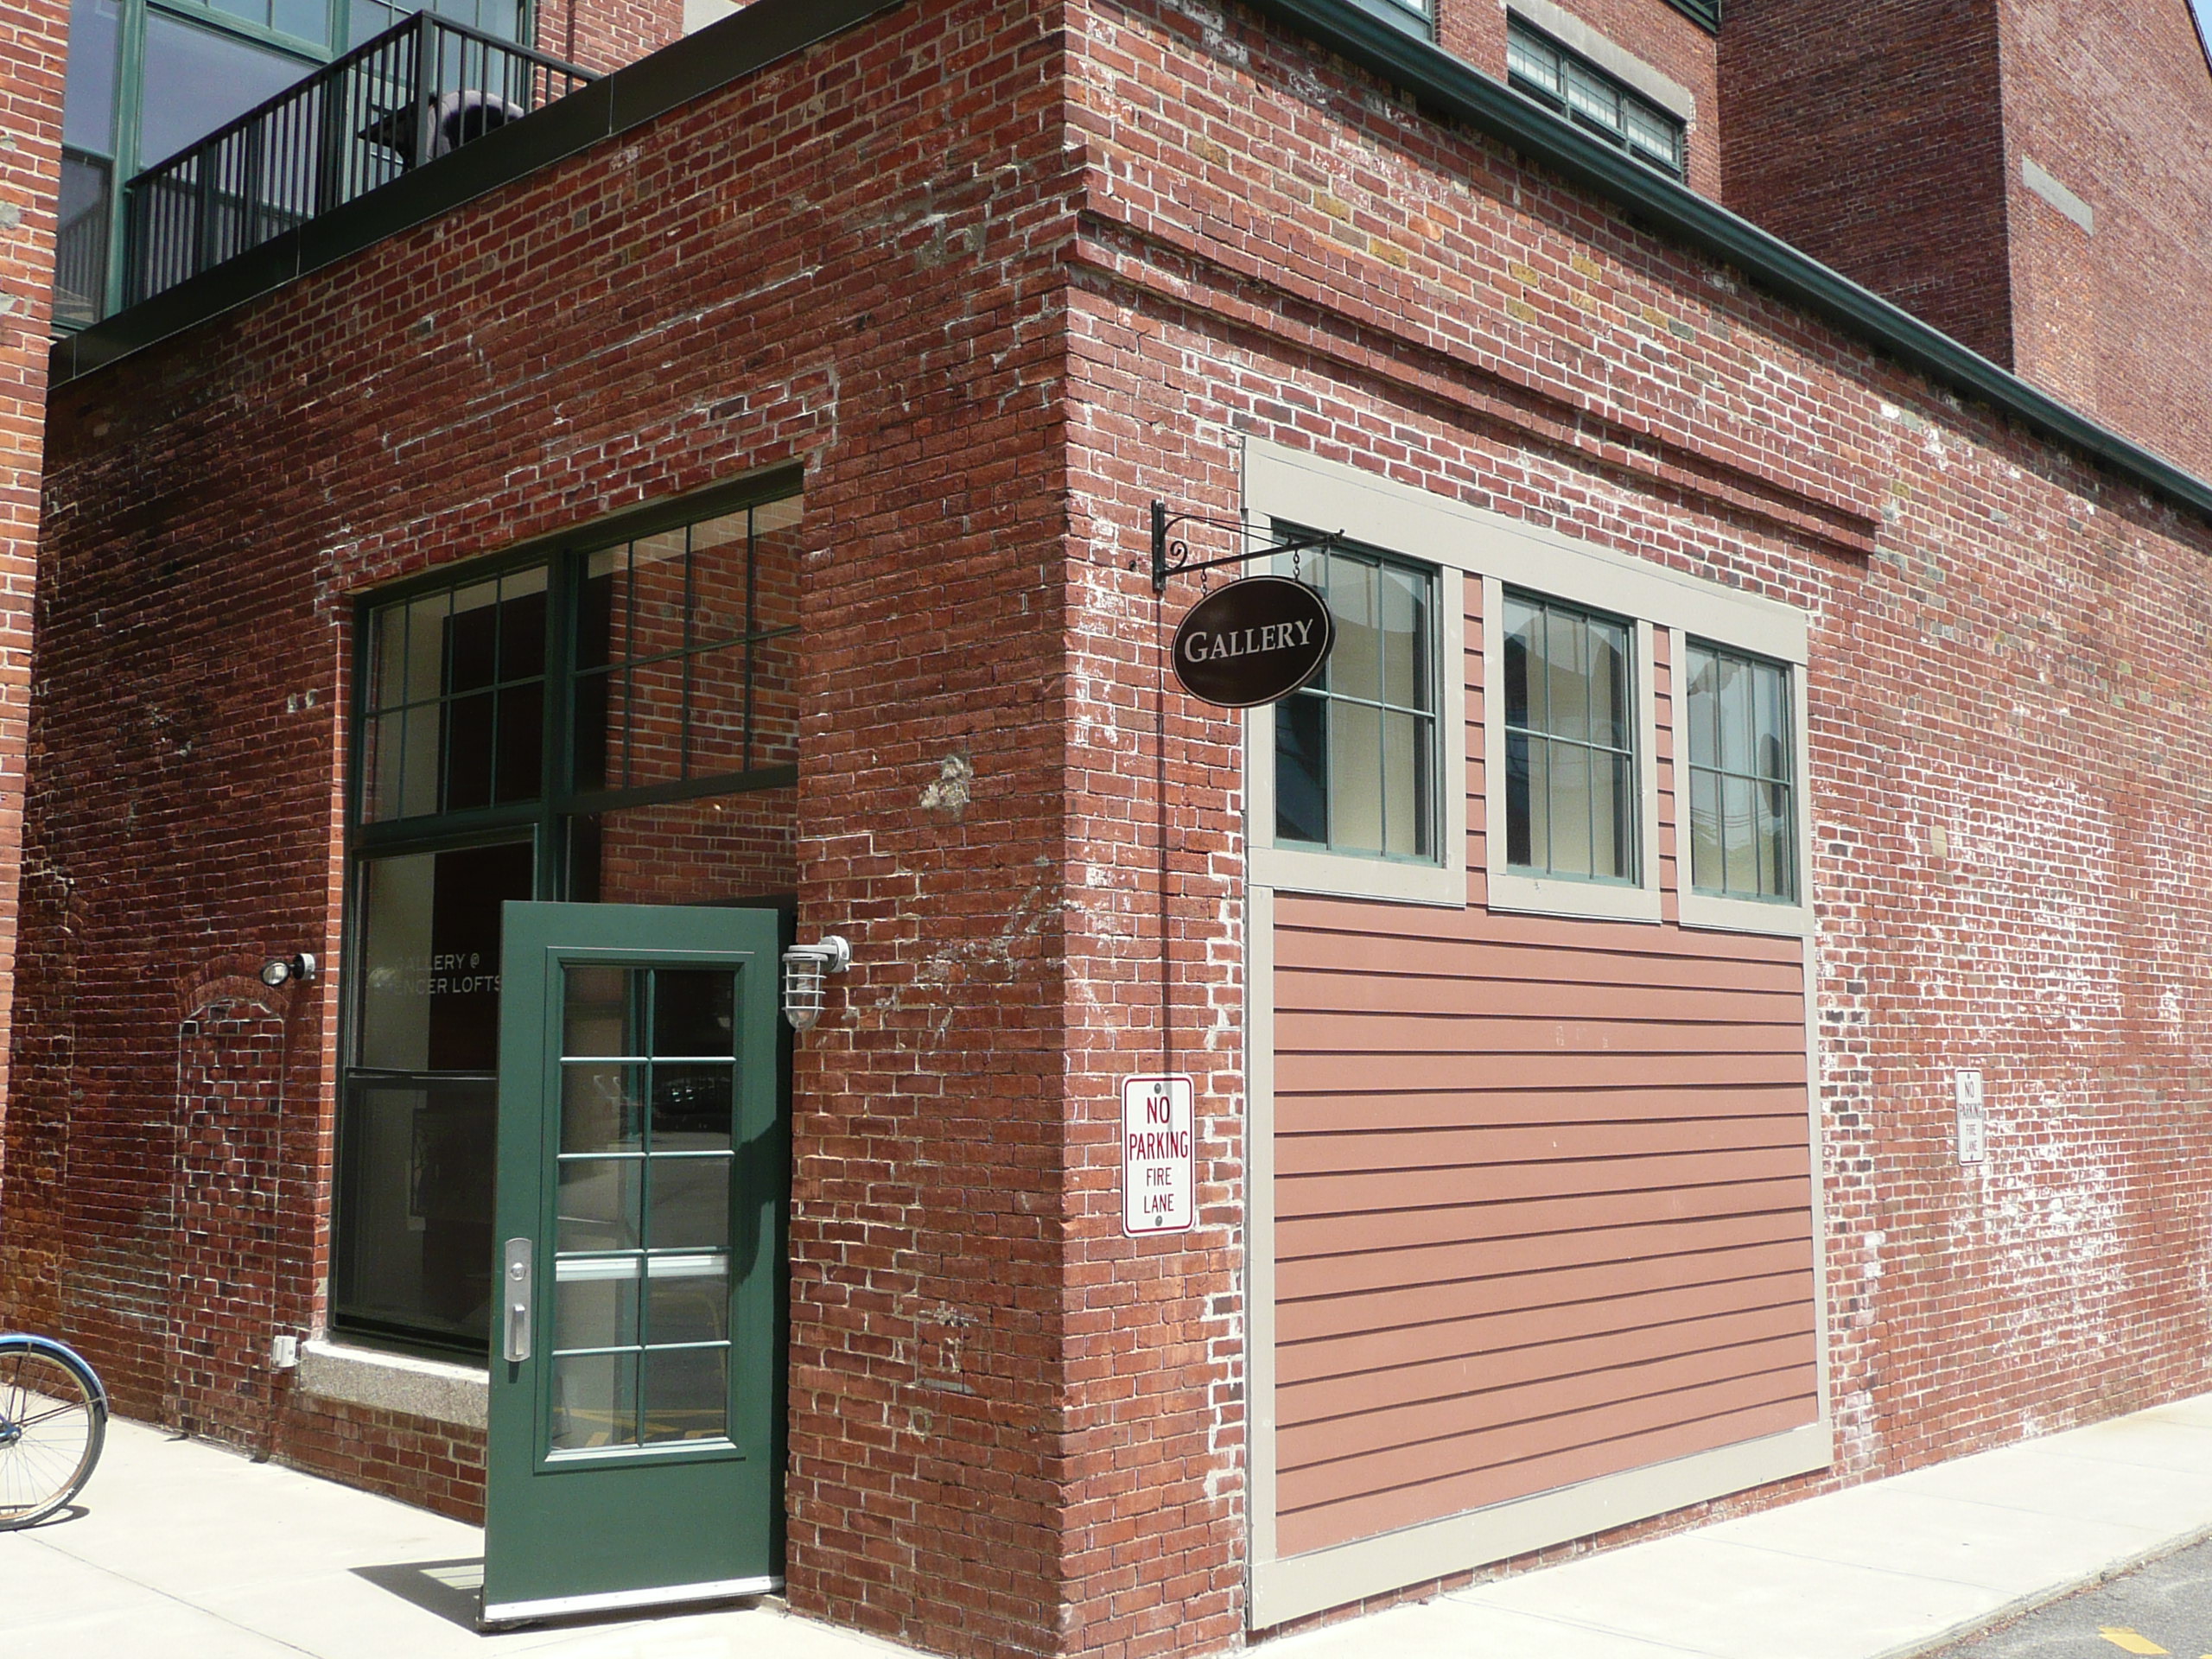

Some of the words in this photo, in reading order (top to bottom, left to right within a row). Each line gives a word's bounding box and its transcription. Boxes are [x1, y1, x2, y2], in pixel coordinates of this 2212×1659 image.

[1184, 618, 1313, 663] GALLERY
[470, 952, 480, 969] @
[1147, 1096, 1171, 1125] NO
[1129, 1130, 1188, 1161] PARKING
[1147, 1167, 1173, 1187] FIRE
[1144, 1193, 1175, 1214] LANE
